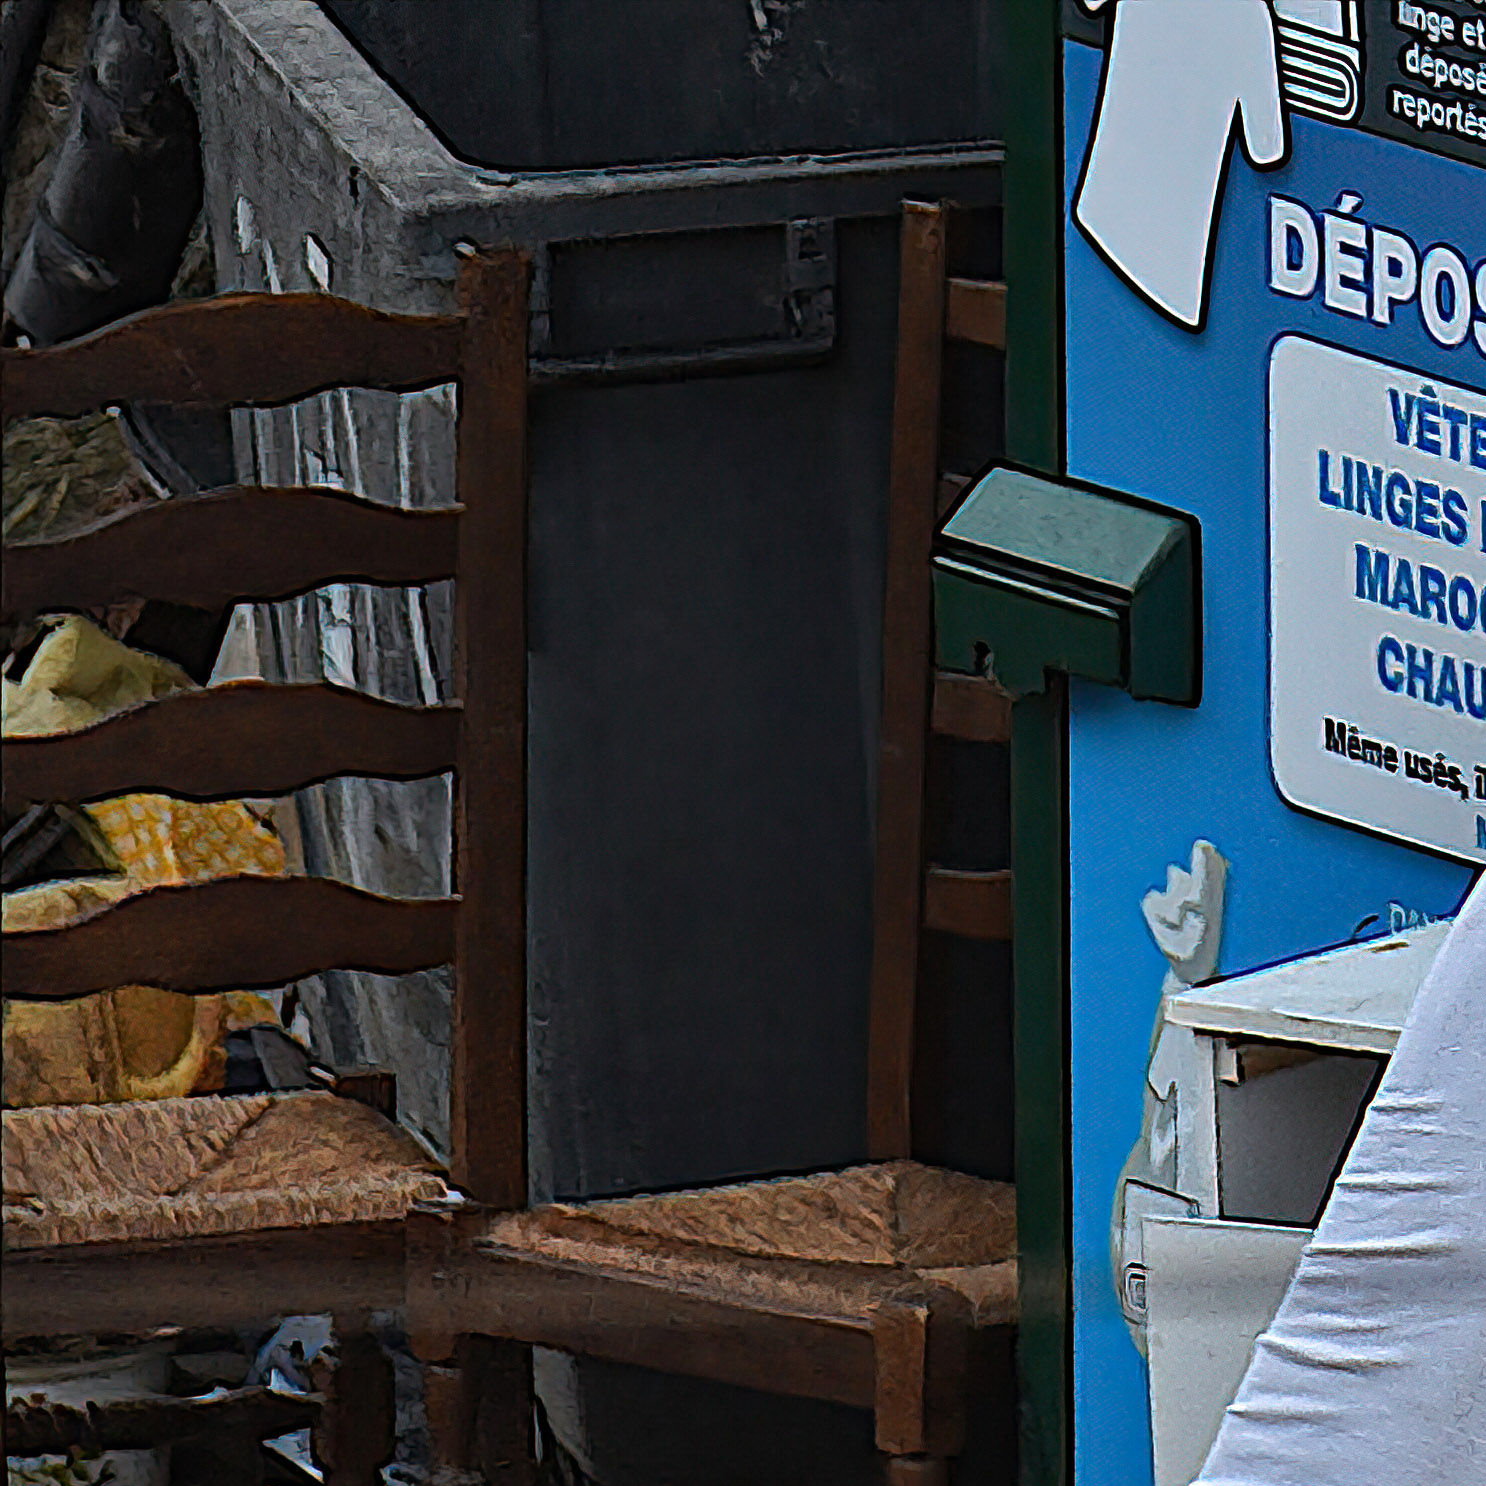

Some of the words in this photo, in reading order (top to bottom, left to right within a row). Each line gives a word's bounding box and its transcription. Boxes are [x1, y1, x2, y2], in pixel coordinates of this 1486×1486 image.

[1462, 18, 1486, 51] et
[1318, 448, 1469, 546] LINGES
[1323, 716, 1399, 774] Même
[1403, 752, 1470, 801] usés,
